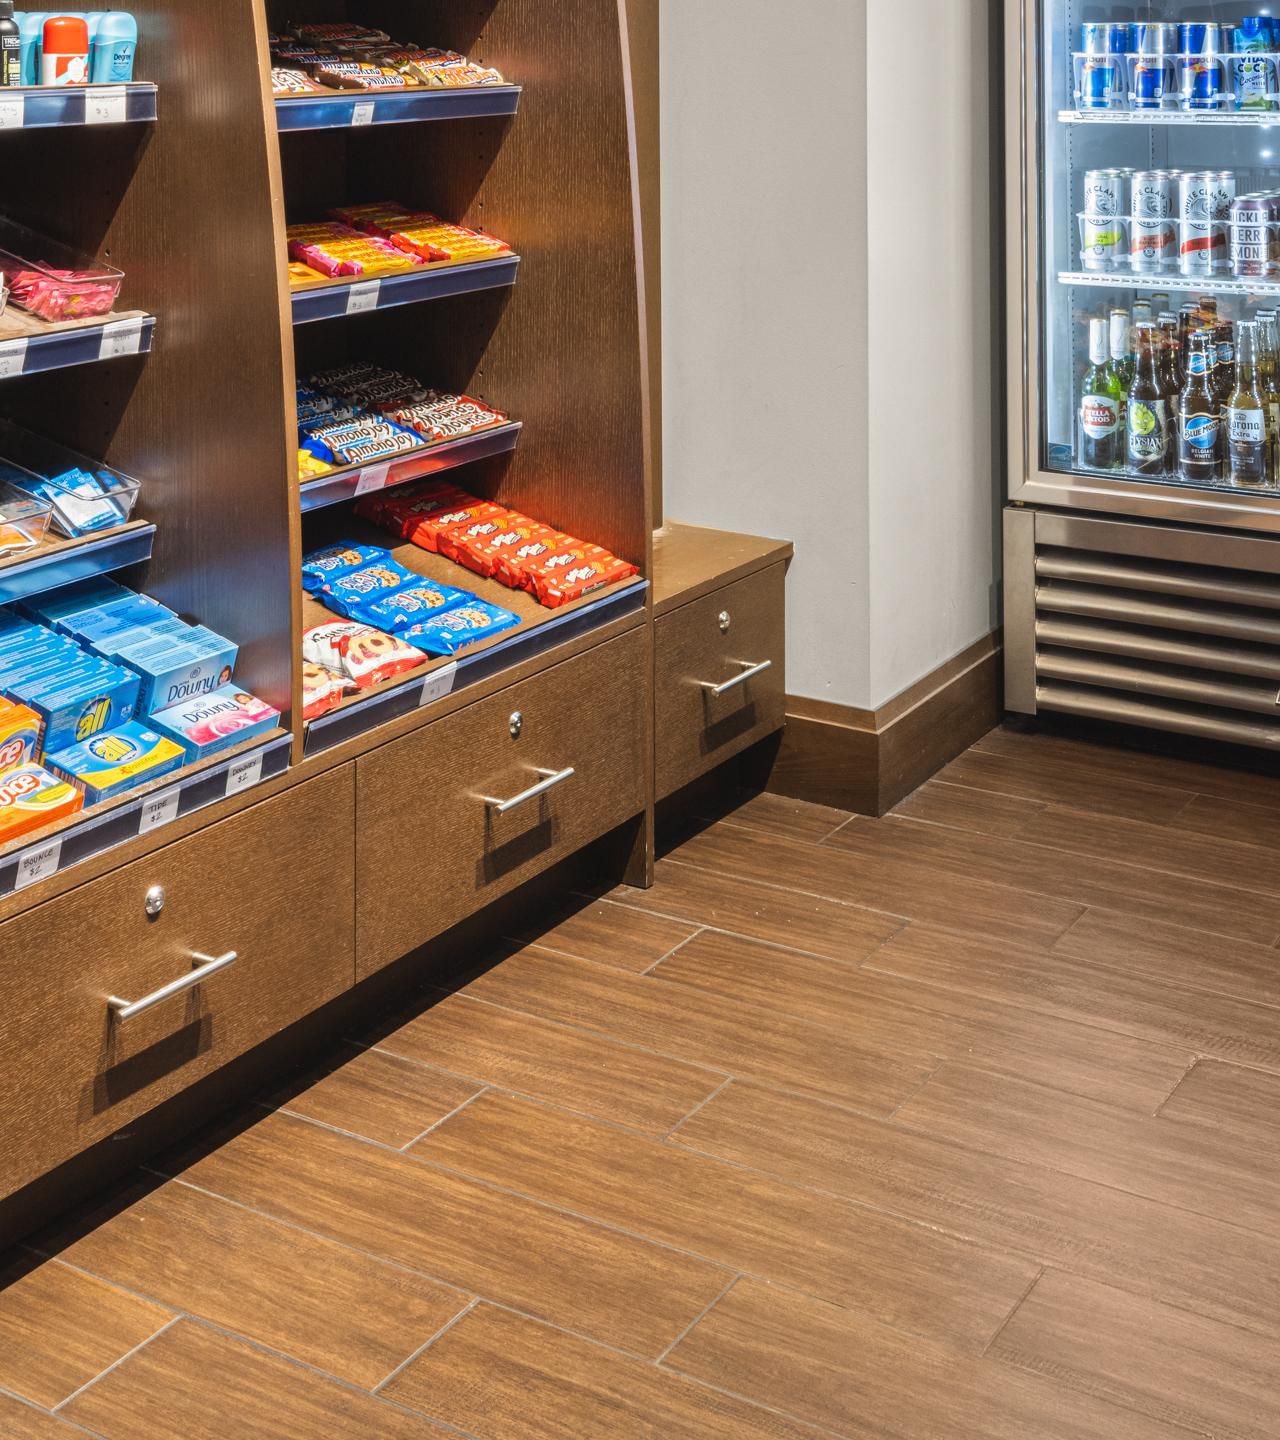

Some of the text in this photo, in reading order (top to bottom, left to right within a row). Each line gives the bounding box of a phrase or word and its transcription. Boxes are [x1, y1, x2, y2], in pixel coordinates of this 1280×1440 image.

[114, 53, 130, 61] Degree
[437, 412, 495, 435] Mounds
[1184, 428, 1202, 439] BLUE
[1130, 437, 1162, 449] ELYSIAN
[168, 675, 214, 702] Downy
[182, 699, 240, 724] Downy
[23, 848, 54, 868] BOUNCE
